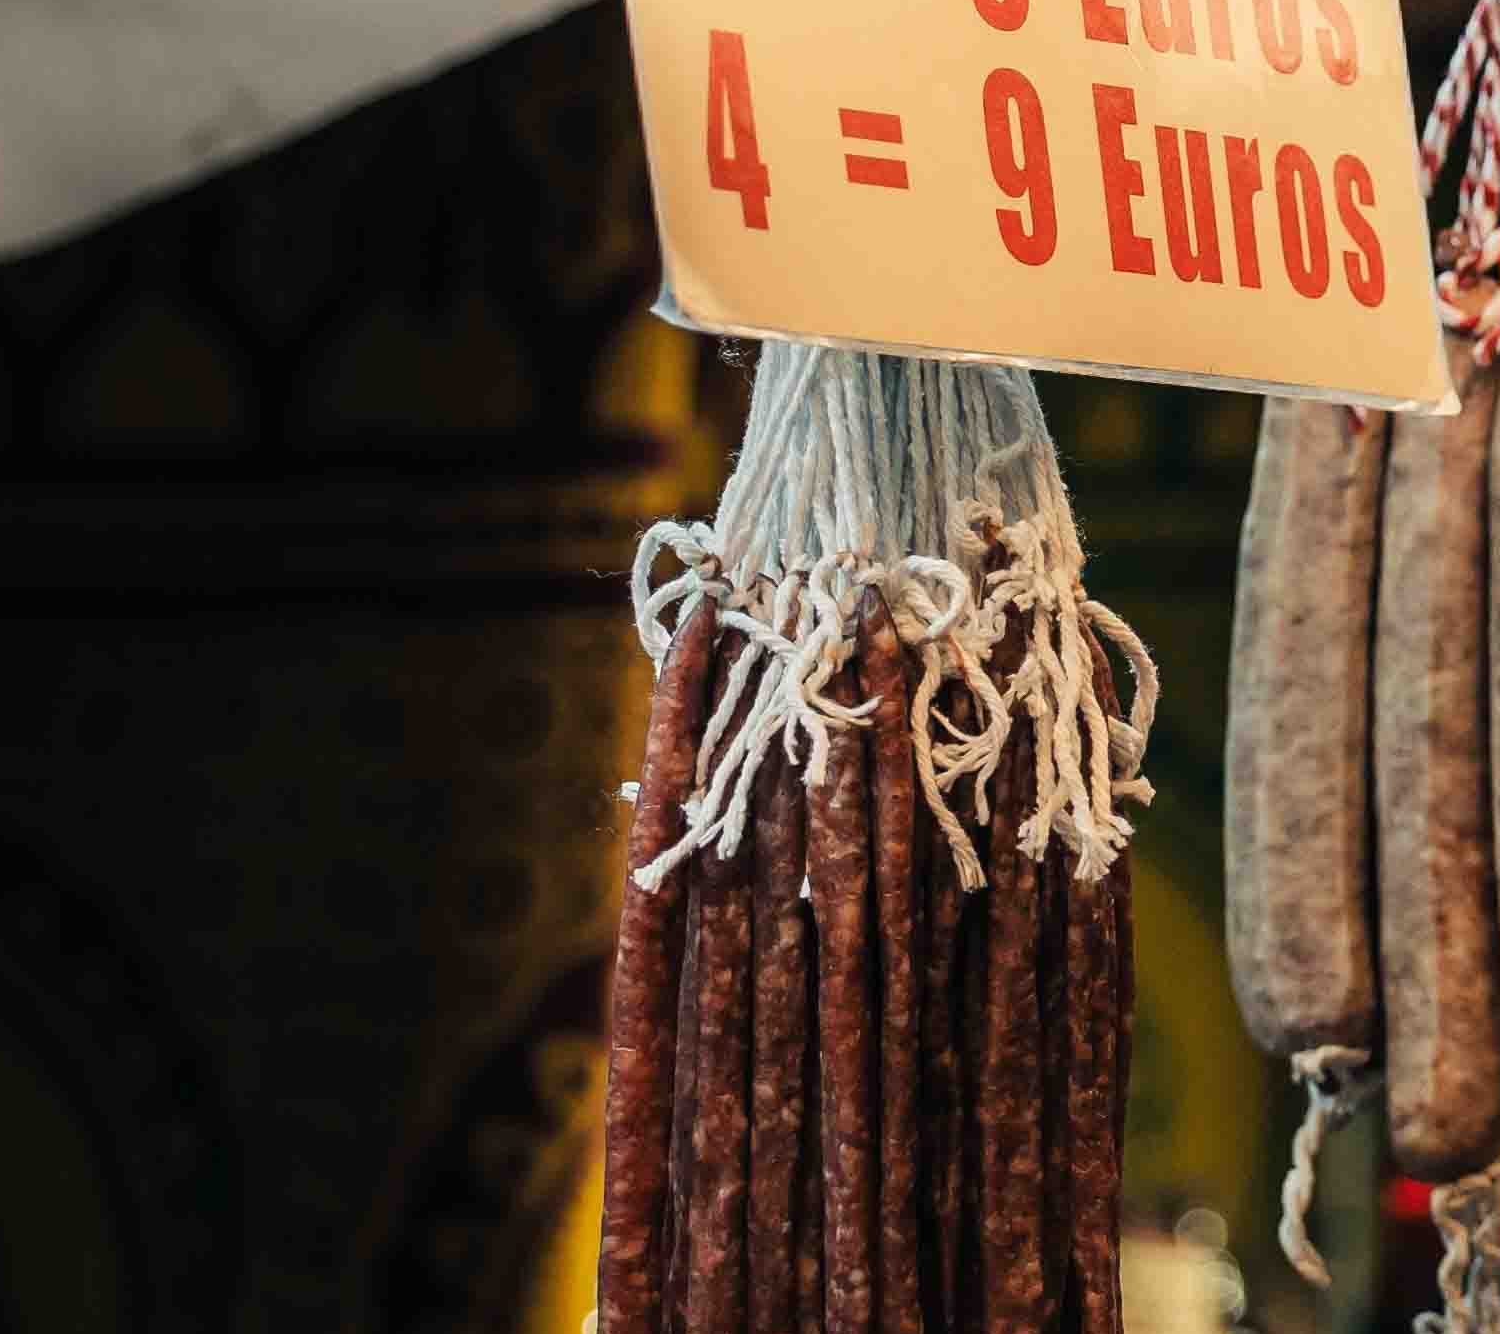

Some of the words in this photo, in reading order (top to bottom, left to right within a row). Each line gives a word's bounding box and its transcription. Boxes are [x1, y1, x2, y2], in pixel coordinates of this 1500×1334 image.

[706, 28, 771, 232] 4
[837, 106, 910, 191] =
[981, 66, 1058, 267] 9
[1091, 82, 1386, 309] Euros
